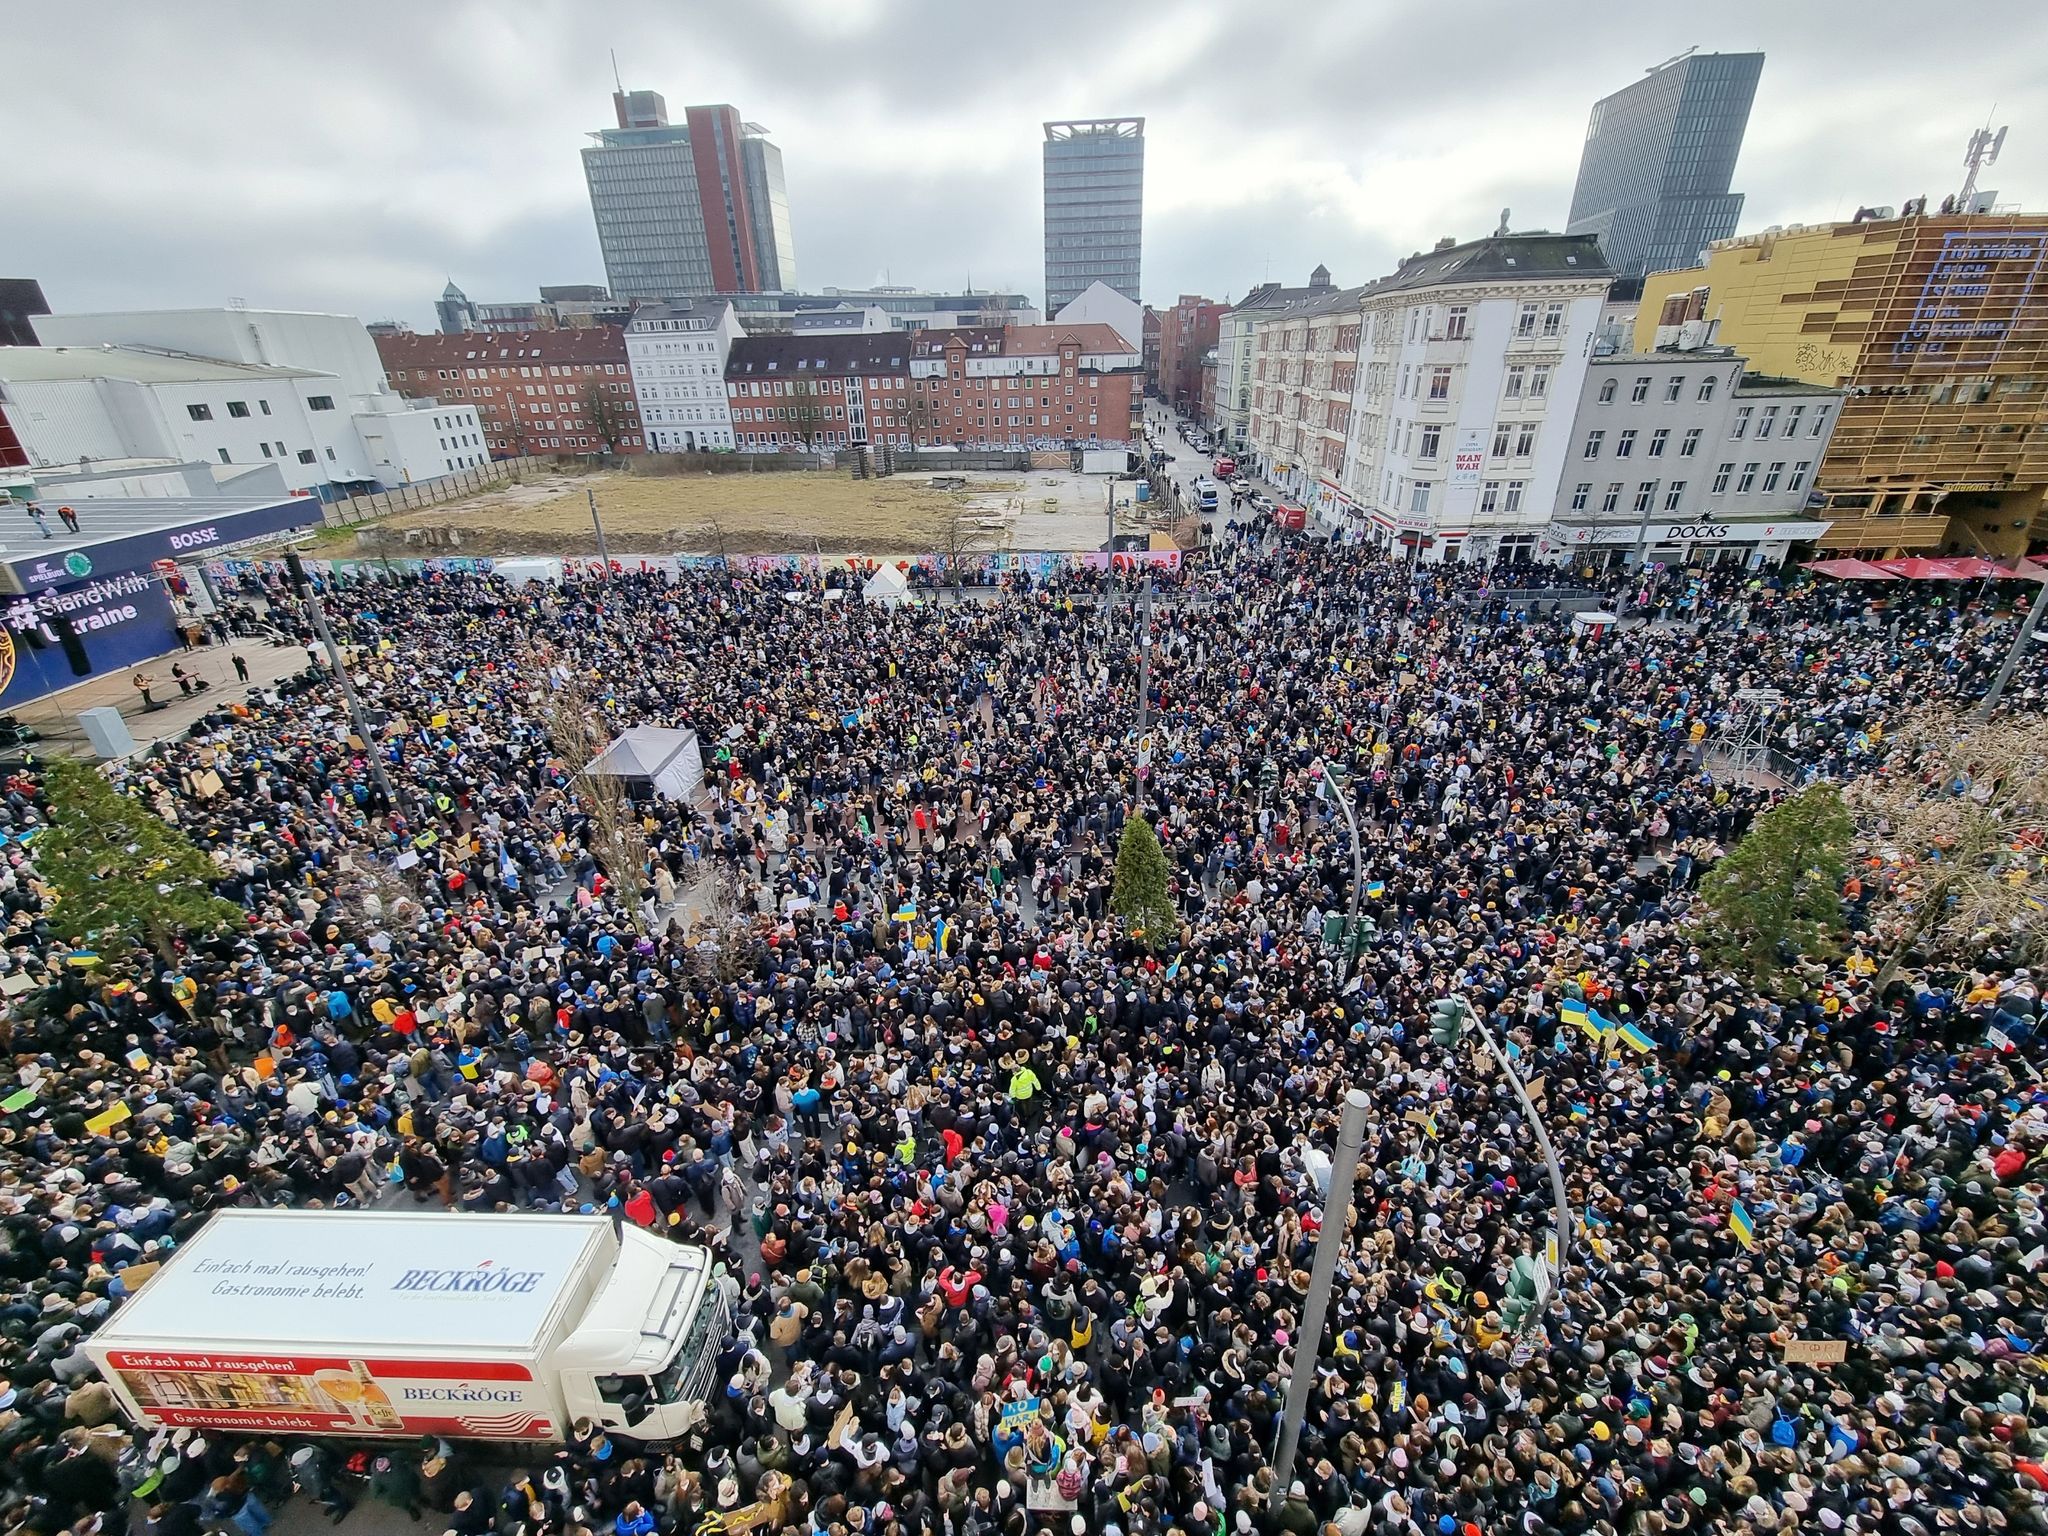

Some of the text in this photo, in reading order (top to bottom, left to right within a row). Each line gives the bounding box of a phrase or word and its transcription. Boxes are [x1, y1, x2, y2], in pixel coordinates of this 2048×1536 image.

[1456, 454, 1482, 462] MAN
[169, 527, 219, 550] BOSSE
[1666, 525, 1731, 539] DOCKS
[28, 568, 67, 583] SPIELBUDE
[193, 1258, 374, 1279] Einfach mal rausgehen!
[391, 1267, 545, 1292] BECKRÖGE
[212, 1280, 366, 1300] Gastronomie belebt.
[1790, 1343, 1841, 1352] STOP!
[122, 1354, 296, 1372] Einfach mal rausgehen!
[404, 1387, 523, 1402] BECKRÖGE
[1008, 1400, 1028, 1412] NO
[173, 1413, 318, 1428] Gastronomie belebt.
